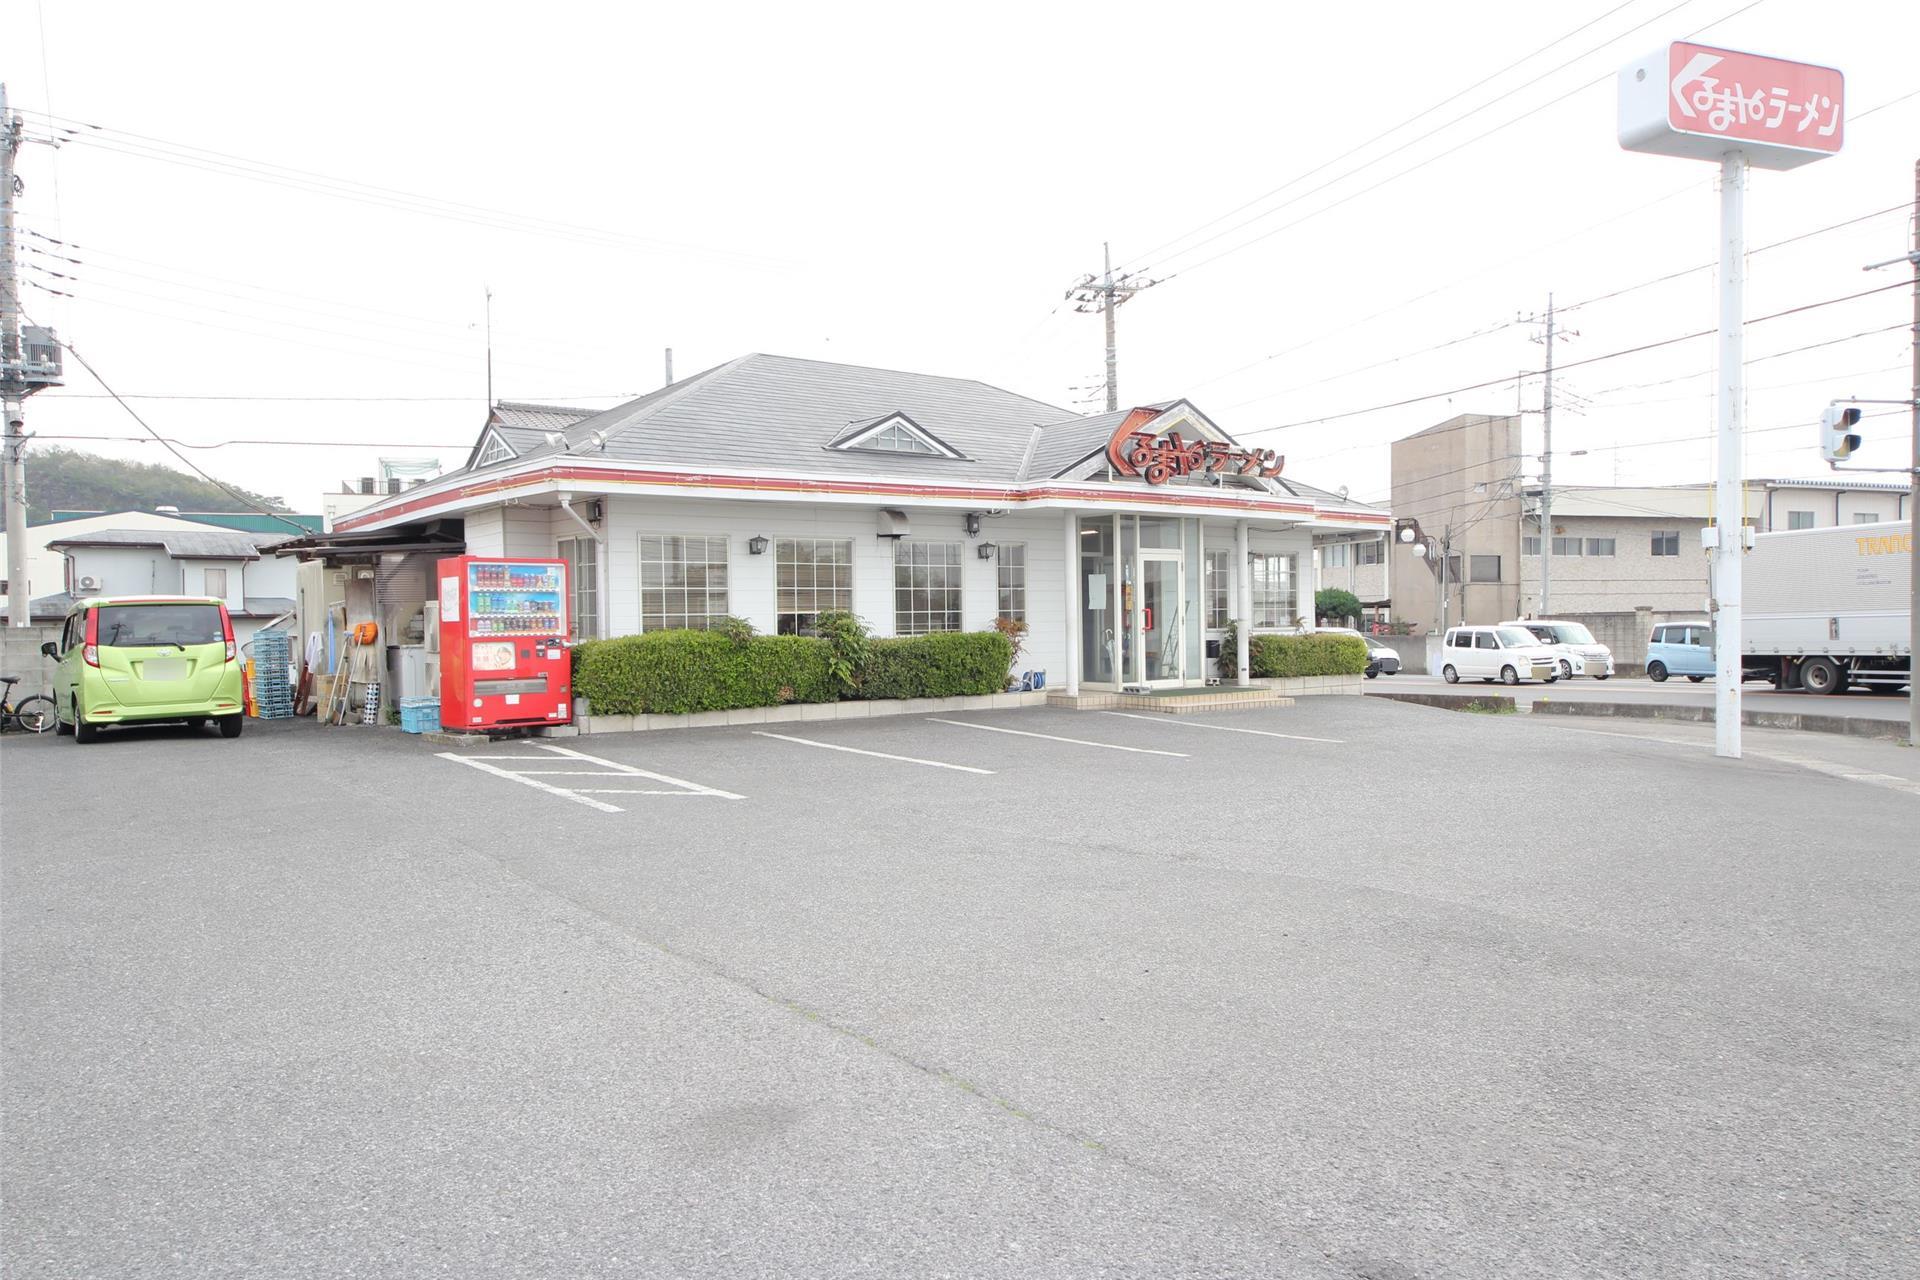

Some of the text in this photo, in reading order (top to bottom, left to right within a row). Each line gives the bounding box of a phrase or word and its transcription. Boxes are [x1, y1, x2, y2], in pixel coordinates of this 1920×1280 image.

[1671, 52, 1840, 136] くるまやラーメン
[1105, 406, 1285, 485] くるまやラーメン
